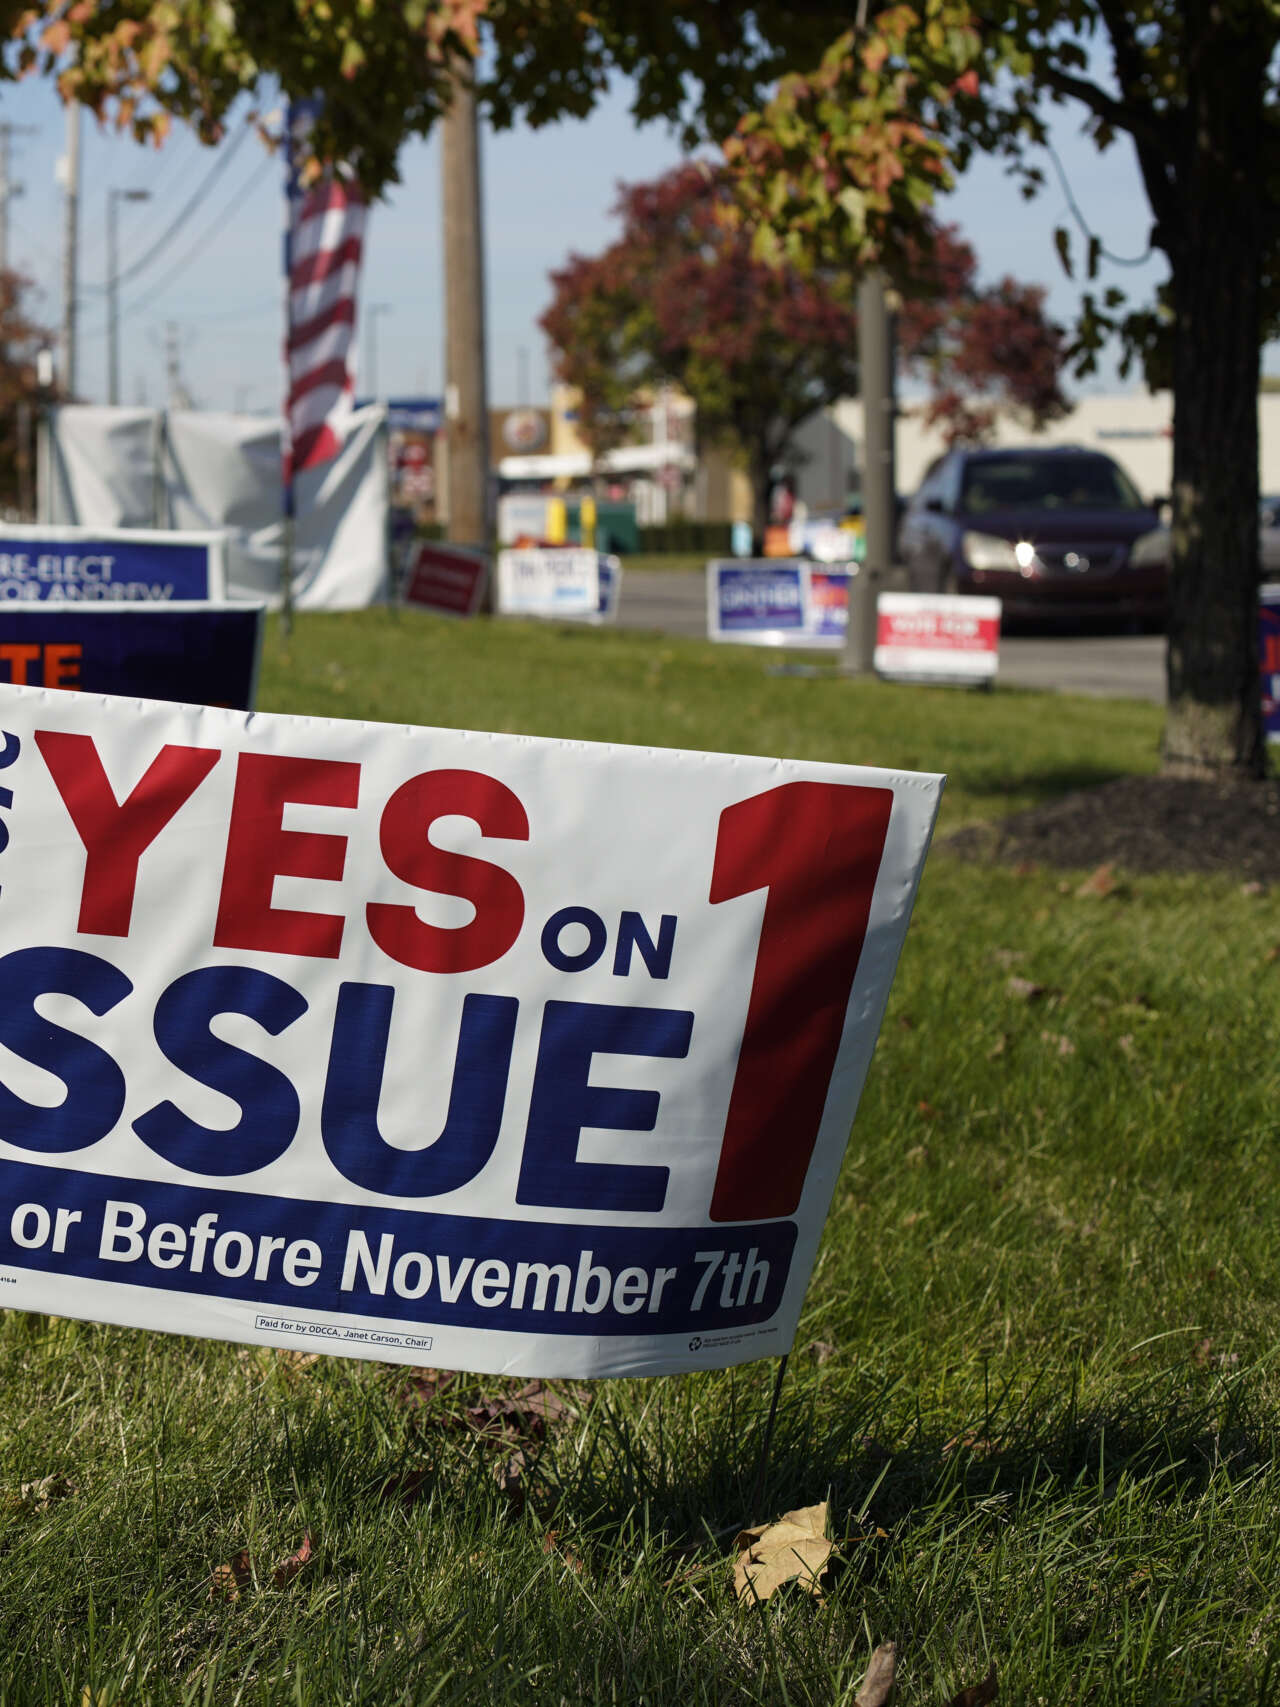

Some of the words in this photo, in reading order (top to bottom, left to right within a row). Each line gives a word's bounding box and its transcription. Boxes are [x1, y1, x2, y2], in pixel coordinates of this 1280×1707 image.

[34, 729, 530, 975] YES
[540, 905, 678, 980] ON
[708, 780, 895, 1223] 1
[10, 1202, 82, 1254] or
[98, 1199, 323, 1288] Before
[339, 1229, 677, 1315] November
[689, 1247, 771, 1312] 7th
[259, 1318, 279, 1330] Paid
[280, 1320, 293, 1331] for
[295, 1322, 308, 1334] by
[308, 1325, 341, 1338] ODCCA,
[343, 1328, 368, 1340] Janet
[370, 1332, 403, 1346] Carson,
[404, 1336, 428, 1348] Chair
